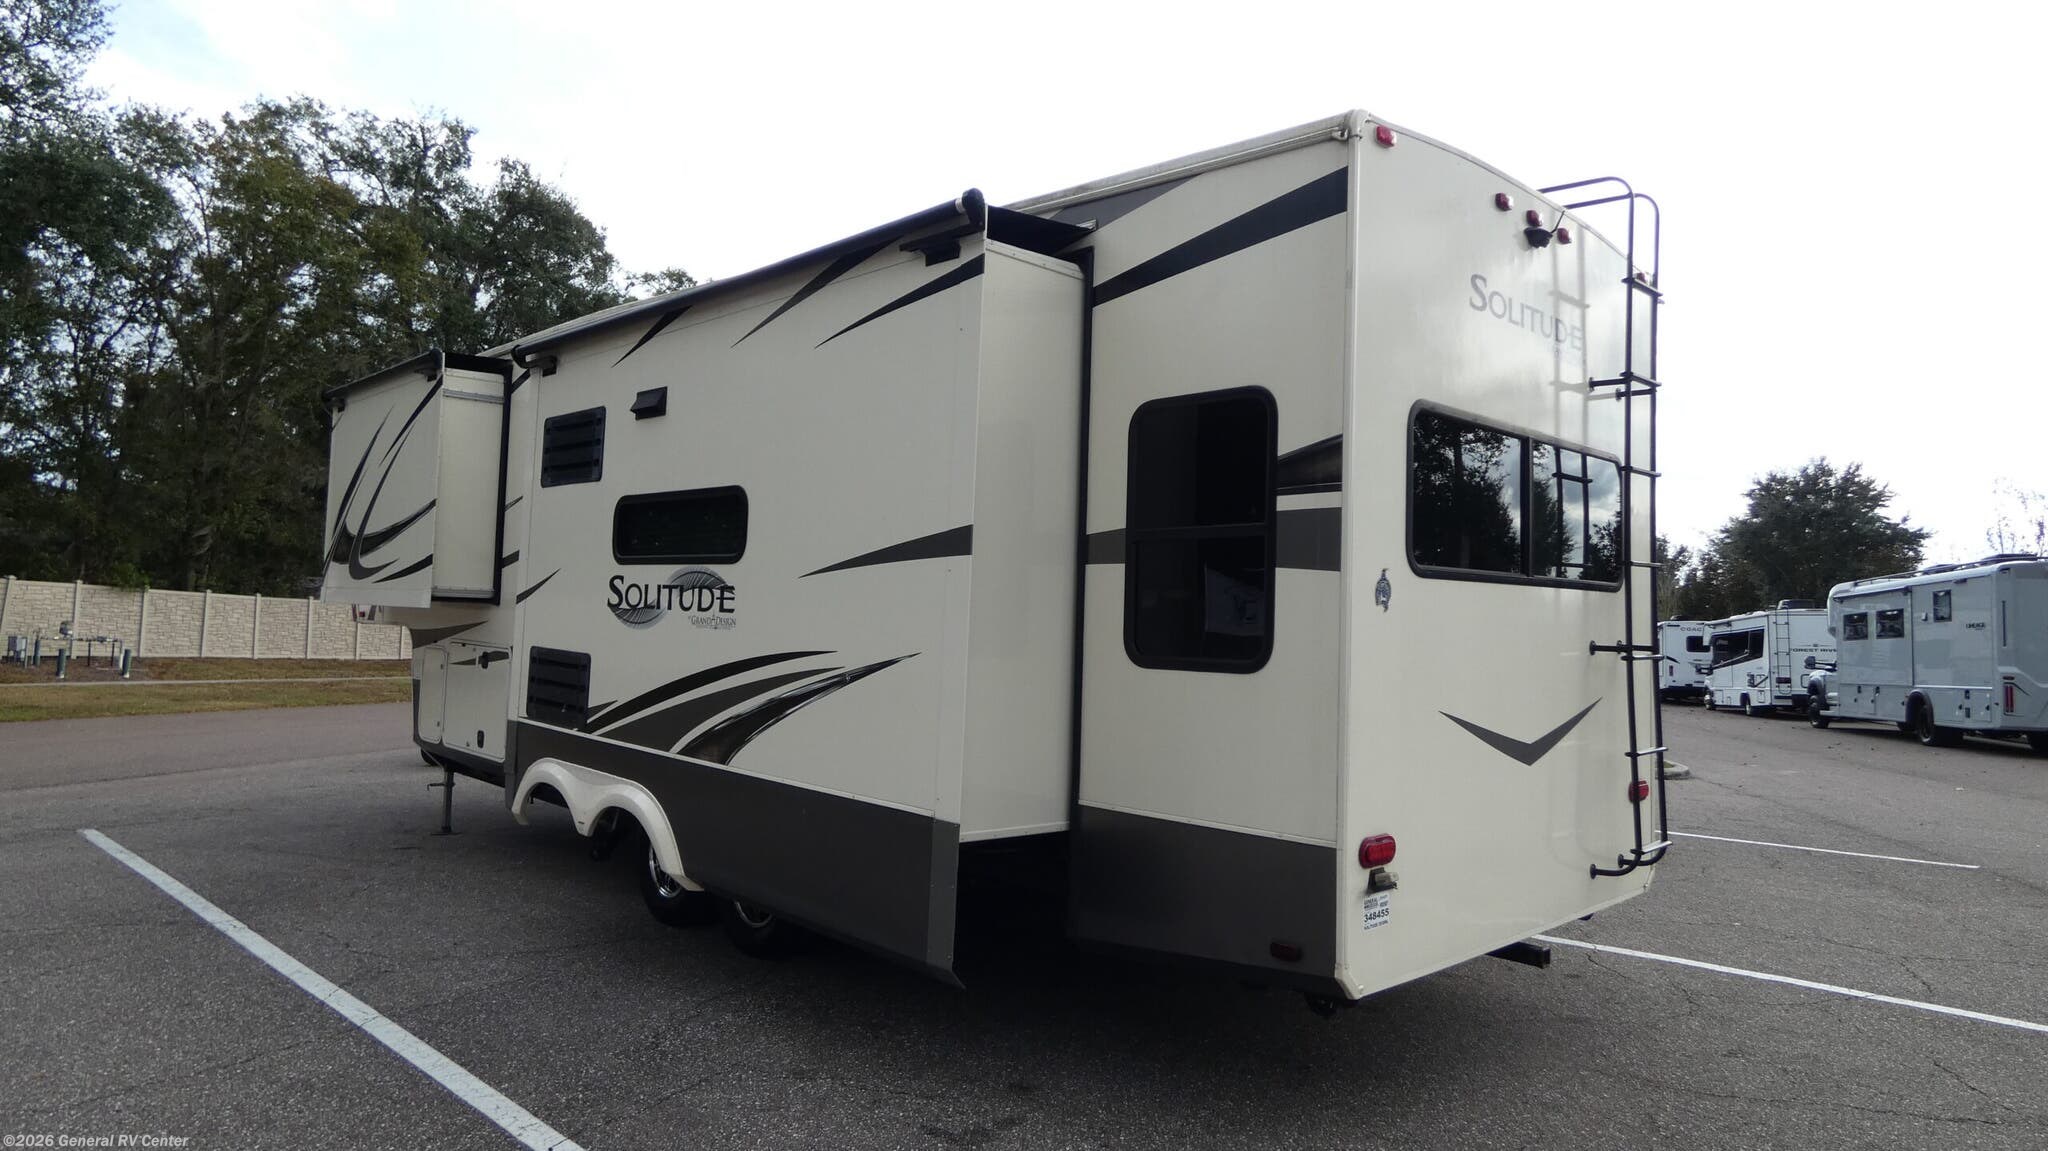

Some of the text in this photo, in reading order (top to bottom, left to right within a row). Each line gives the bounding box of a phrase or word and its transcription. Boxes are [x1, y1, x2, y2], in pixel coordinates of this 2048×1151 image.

[1469, 273, 1583, 351] SOLITUDE
[607, 575, 736, 614] SOLITUDE
[1364, 908, 1390, 923] 348455
